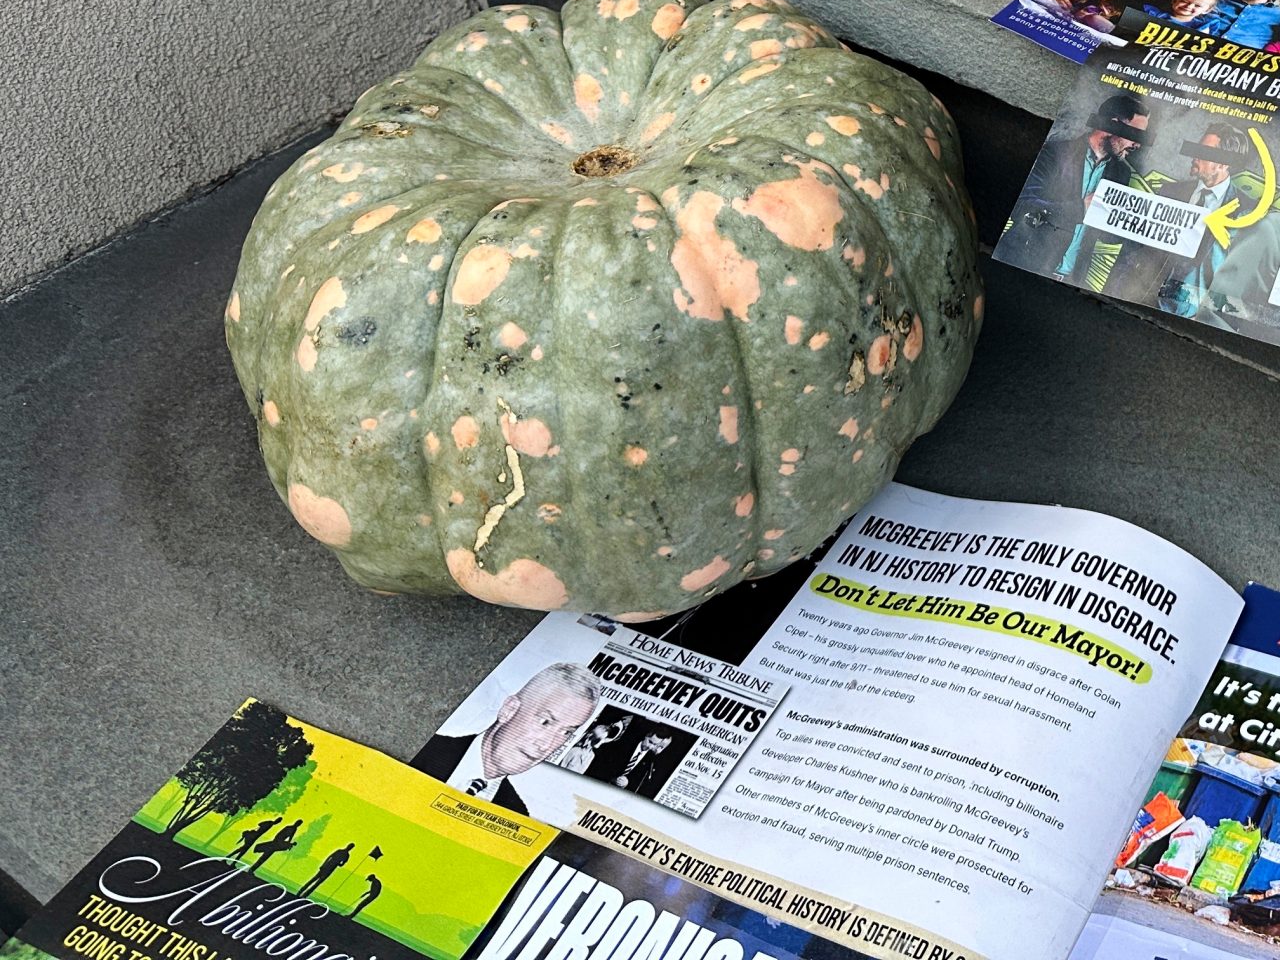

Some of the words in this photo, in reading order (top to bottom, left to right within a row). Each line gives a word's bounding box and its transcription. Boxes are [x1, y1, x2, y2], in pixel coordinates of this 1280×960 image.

[1135, 22, 1215, 54] BILL'S
[1141, 48, 1180, 71] THE
[1176, 53, 1268, 95] COMPANY
[963, 534, 982, 554] IS
[985, 535, 1020, 559] THE
[1021, 541, 1074, 569] ONLY
[1071, 551, 1178, 616] GOVERNOR
[816, 575, 878, 606] Don't
[879, 591, 917, 611] Let
[914, 595, 966, 619] Him
[967, 604, 999, 626] Be
[1002, 611, 1051, 638] Our
[1049, 624, 1145, 680] Mayor!
[699, 693, 767, 733] QUITS
[1212, 676, 1262, 704] It's
[1199, 712, 1234, 733] at
[786, 710, 842, 729] McGreevey's
[843, 722, 909, 745] administration
[910, 739, 930, 751] was
[931, 745, 998, 770] surrounded
[989, 762, 1003, 776] by
[1003, 769, 1061, 802] corruption.
[78, 895, 167, 946] THOUGHT
